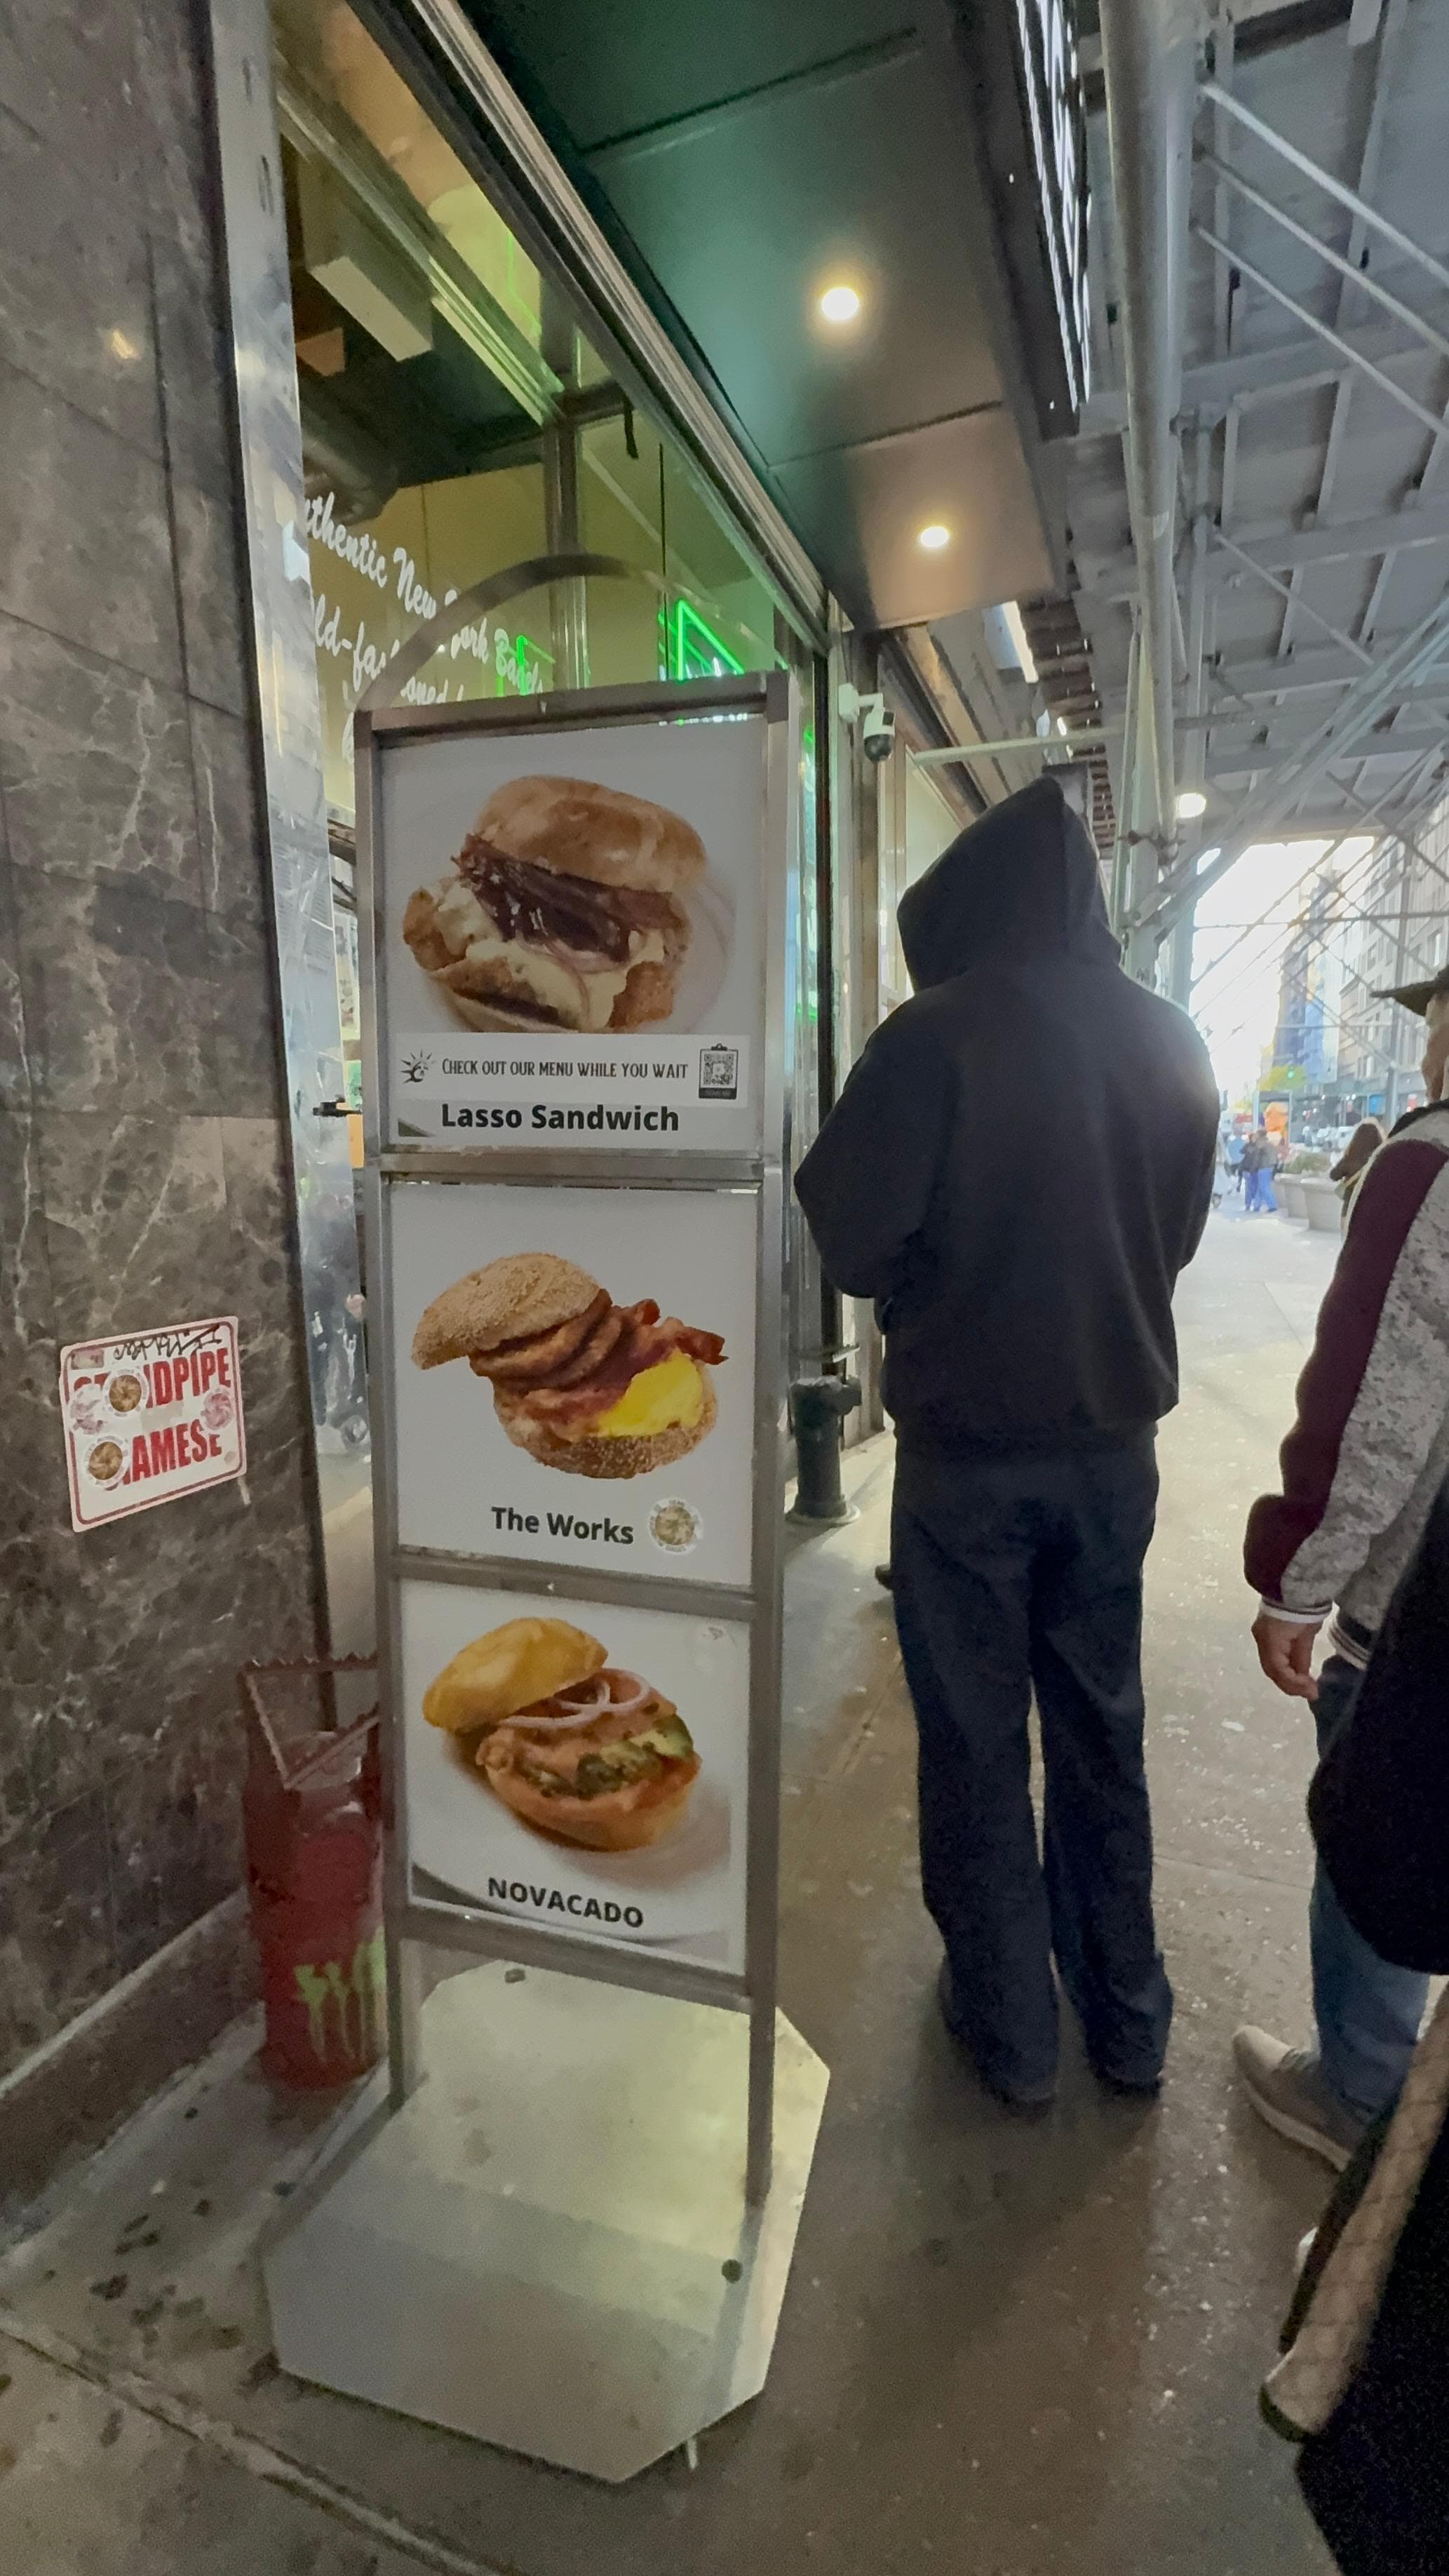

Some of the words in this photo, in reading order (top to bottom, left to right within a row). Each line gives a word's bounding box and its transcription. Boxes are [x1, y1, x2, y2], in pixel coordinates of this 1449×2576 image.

[393, 546, 436, 619] New
[442, 1058, 478, 1075] CHECK
[482, 1060, 507, 1076] OUT
[510, 1061, 535, 1077] OUR
[539, 1061, 574, 1078] MENU
[577, 1062, 617, 1078] WHILE
[621, 1063, 648, 1079] YOU
[652, 1064, 689, 1079] WAIT
[442, 1103, 523, 1129] Lasso
[532, 1104, 679, 1131] Sandwich
[491, 1506, 539, 1534] The
[546, 1512, 634, 1545] Works
[488, 1877, 644, 1928] NOVACADO
